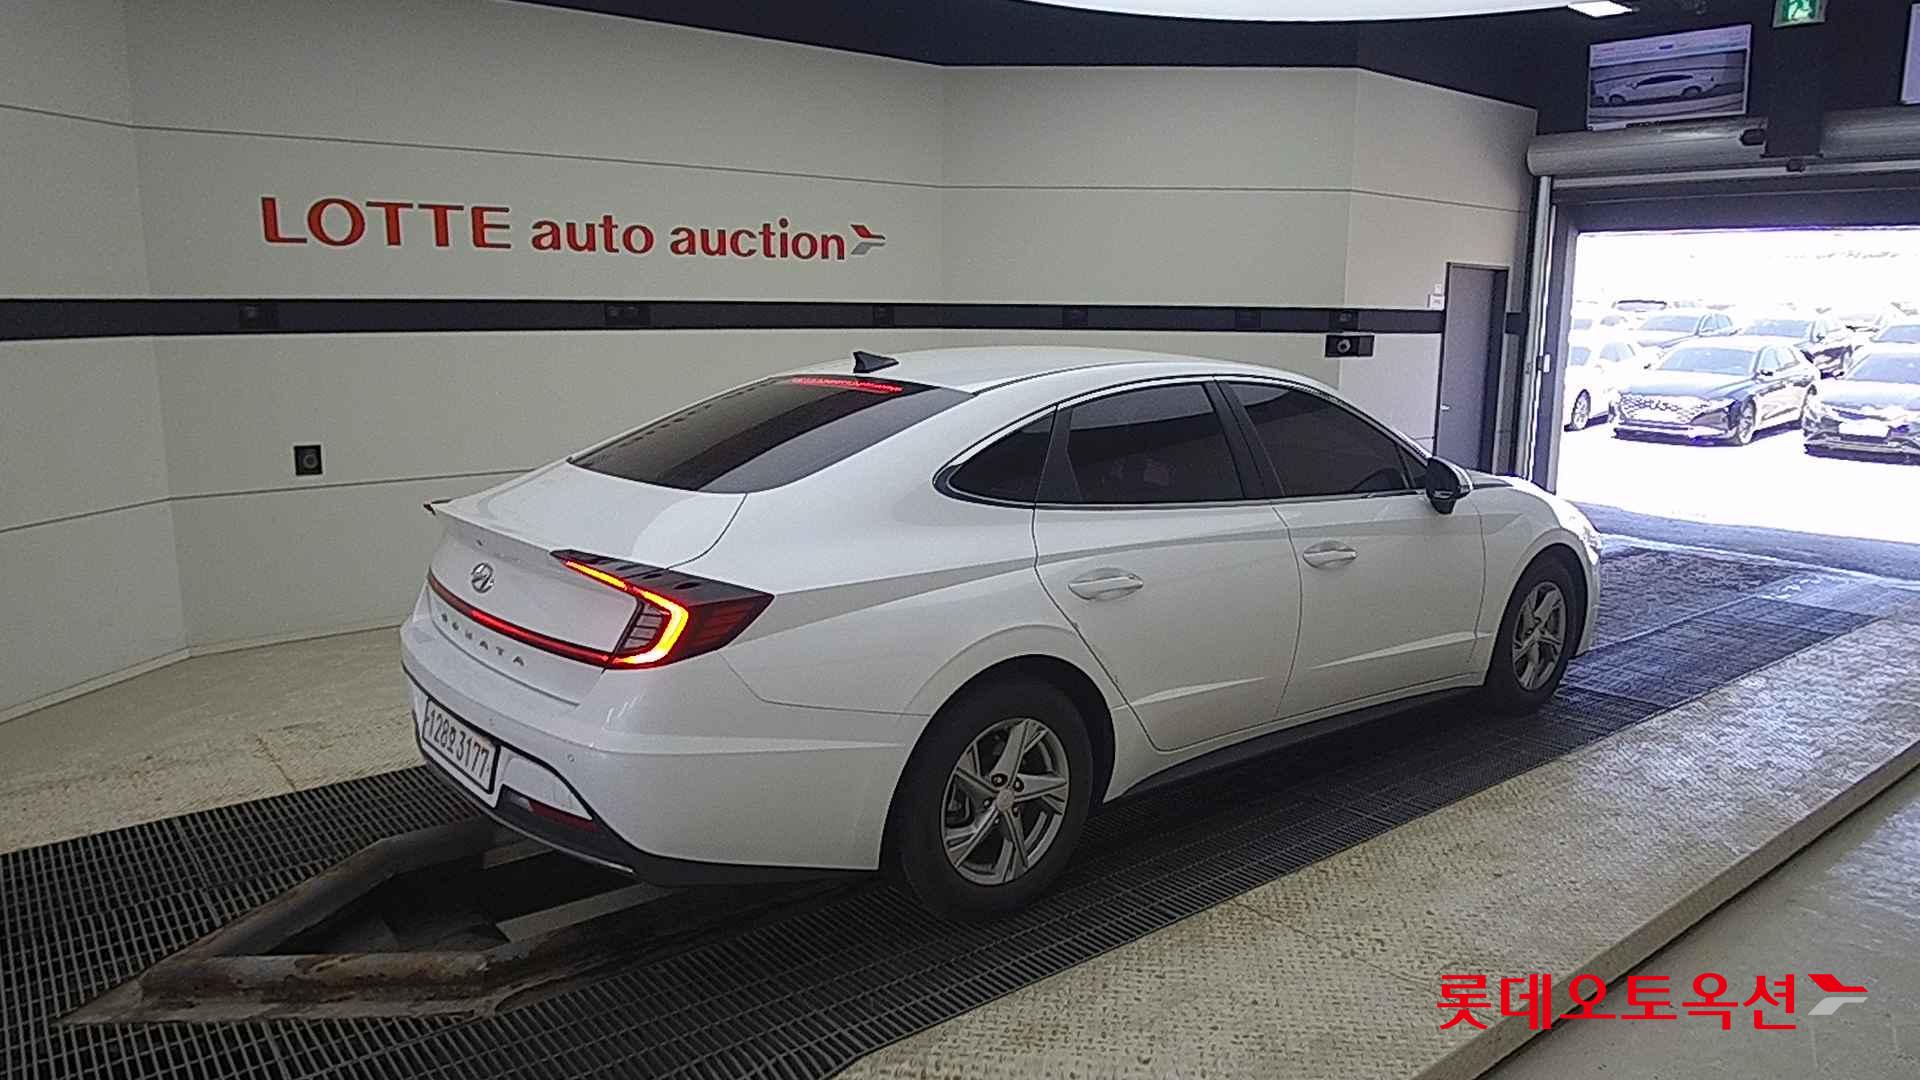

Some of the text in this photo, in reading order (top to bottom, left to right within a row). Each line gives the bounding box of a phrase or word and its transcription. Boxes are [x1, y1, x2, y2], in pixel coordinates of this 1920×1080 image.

[260, 196, 846, 261] LOTTE auto auction
